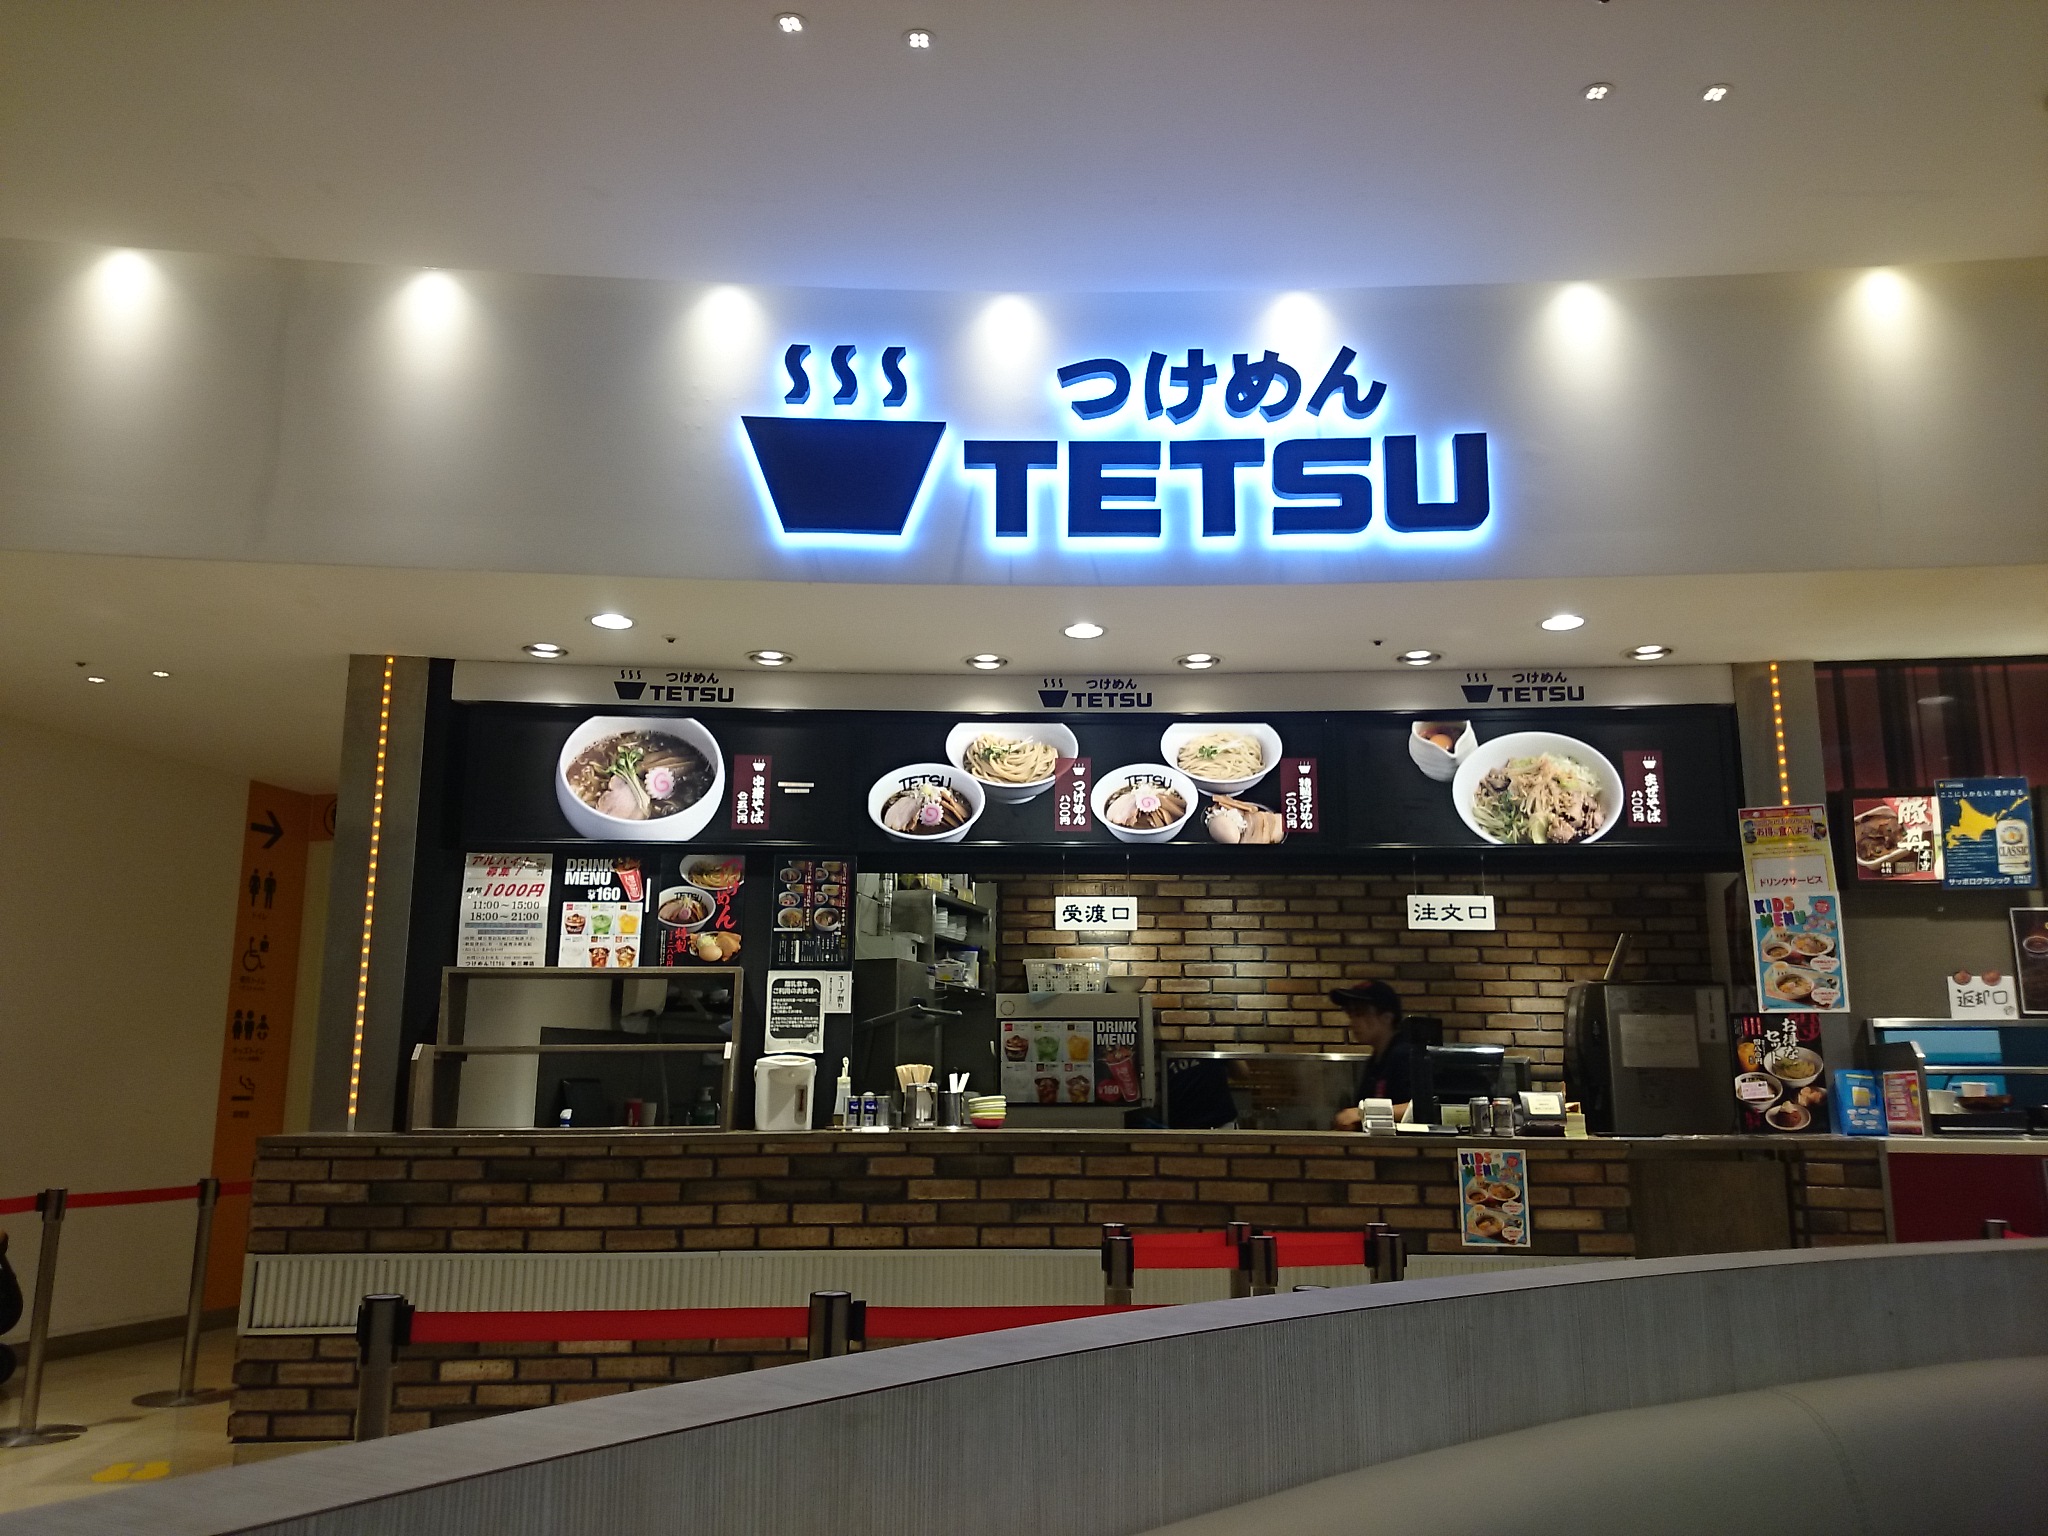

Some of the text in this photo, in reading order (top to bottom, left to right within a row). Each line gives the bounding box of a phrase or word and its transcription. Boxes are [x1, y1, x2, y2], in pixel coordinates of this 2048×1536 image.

[1057, 345, 1387, 424] つけめん
[963, 432, 1490, 538] TETSU
[666, 672, 720, 685] つけめん
[1085, 678, 1137, 691] つけめん
[1512, 671, 1568, 684] つけめん
[650, 684, 735, 703] TETSU
[1071, 692, 1153, 708] TETSU
[1497, 686, 1586, 703] TETSU
[750, 774, 765, 824] 中華そば
[1072, 780, 1086, 826] つけめん
[1298, 776, 1313, 830] 特製つけめん
[1644, 772, 1662, 823] まぜそば
[566, 858, 615, 872] DRINK
[564, 871, 612, 886] MENU
[1759, 875, 1824, 888] ドリンクサービス
[1061, 903, 1131, 924] 受渡口
[1413, 902, 1488, 923] 注文口
[1753, 896, 1796, 914] KIDS
[1759, 910, 1807, 928] MENU
[1956, 989, 2008, 1009] 返却口
[1096, 1021, 1138, 1033] DRINK
[1096, 1033, 1136, 1046] MENU
[1764, 1030, 1782, 1065] セット
[1781, 1018, 1800, 1060] お得な
[1460, 1151, 1492, 1166] KIDS
